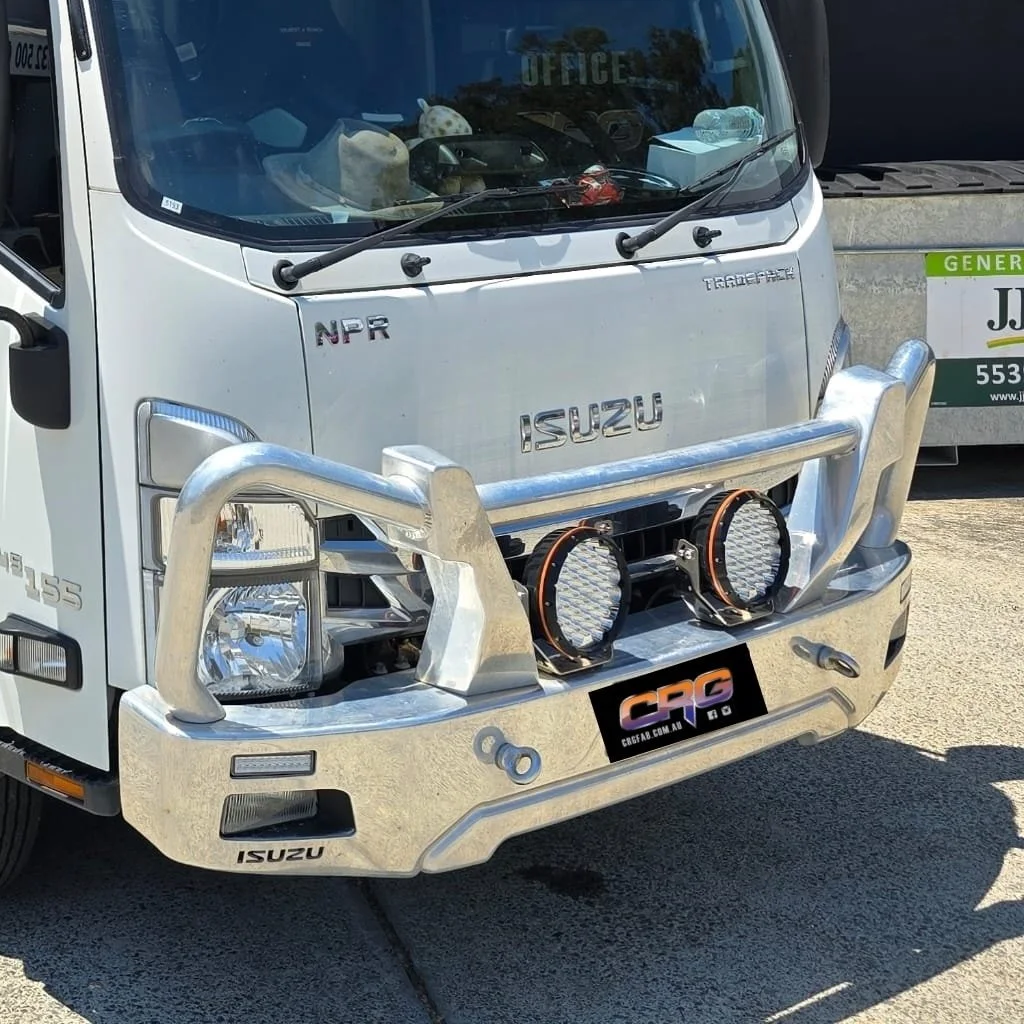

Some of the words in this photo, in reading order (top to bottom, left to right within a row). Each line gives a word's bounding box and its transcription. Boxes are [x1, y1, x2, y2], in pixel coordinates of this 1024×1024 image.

[521, 51, 629, 87] OFFICE
[315, 314, 391, 347] NPR
[519, 391, 663, 454] ISUZU
[24, 565, 83, 611] 155
[619, 667, 734, 731] CRG
[621, 721, 683, 747] CRGFAB.COM.AU
[237, 846, 325, 864] ISUZU
